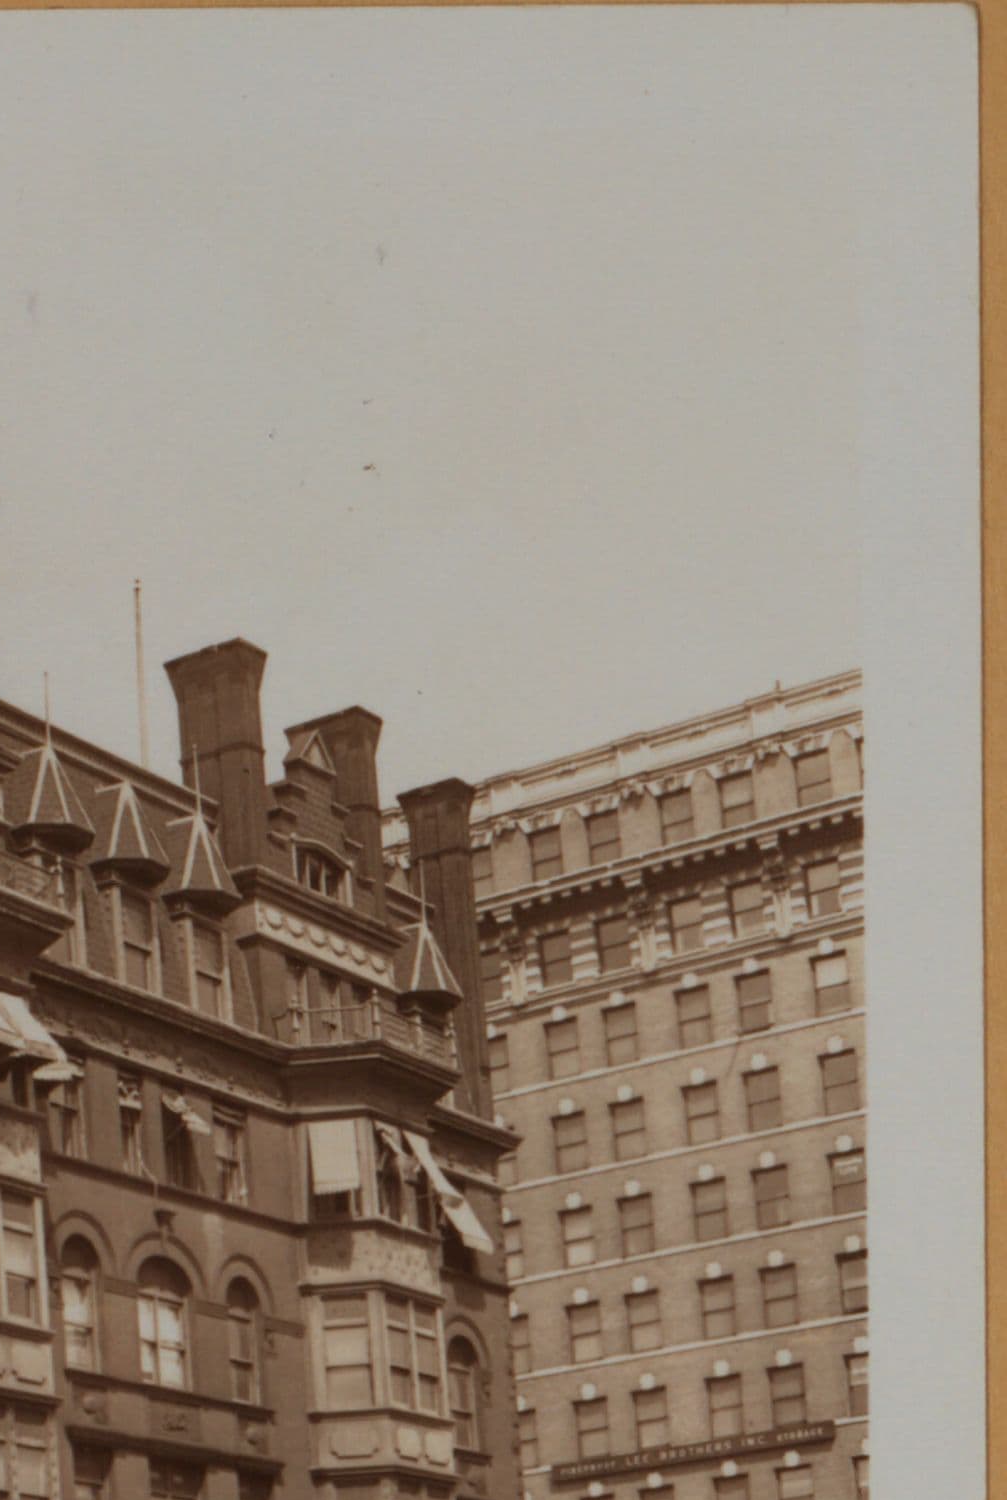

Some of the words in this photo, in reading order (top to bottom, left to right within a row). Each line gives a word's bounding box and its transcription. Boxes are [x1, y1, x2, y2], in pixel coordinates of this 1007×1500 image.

[625, 1453, 649, 1468] LEE
[659, 1440, 733, 1461] BROTHERS
[776, 1426, 824, 1442] STORAGE
